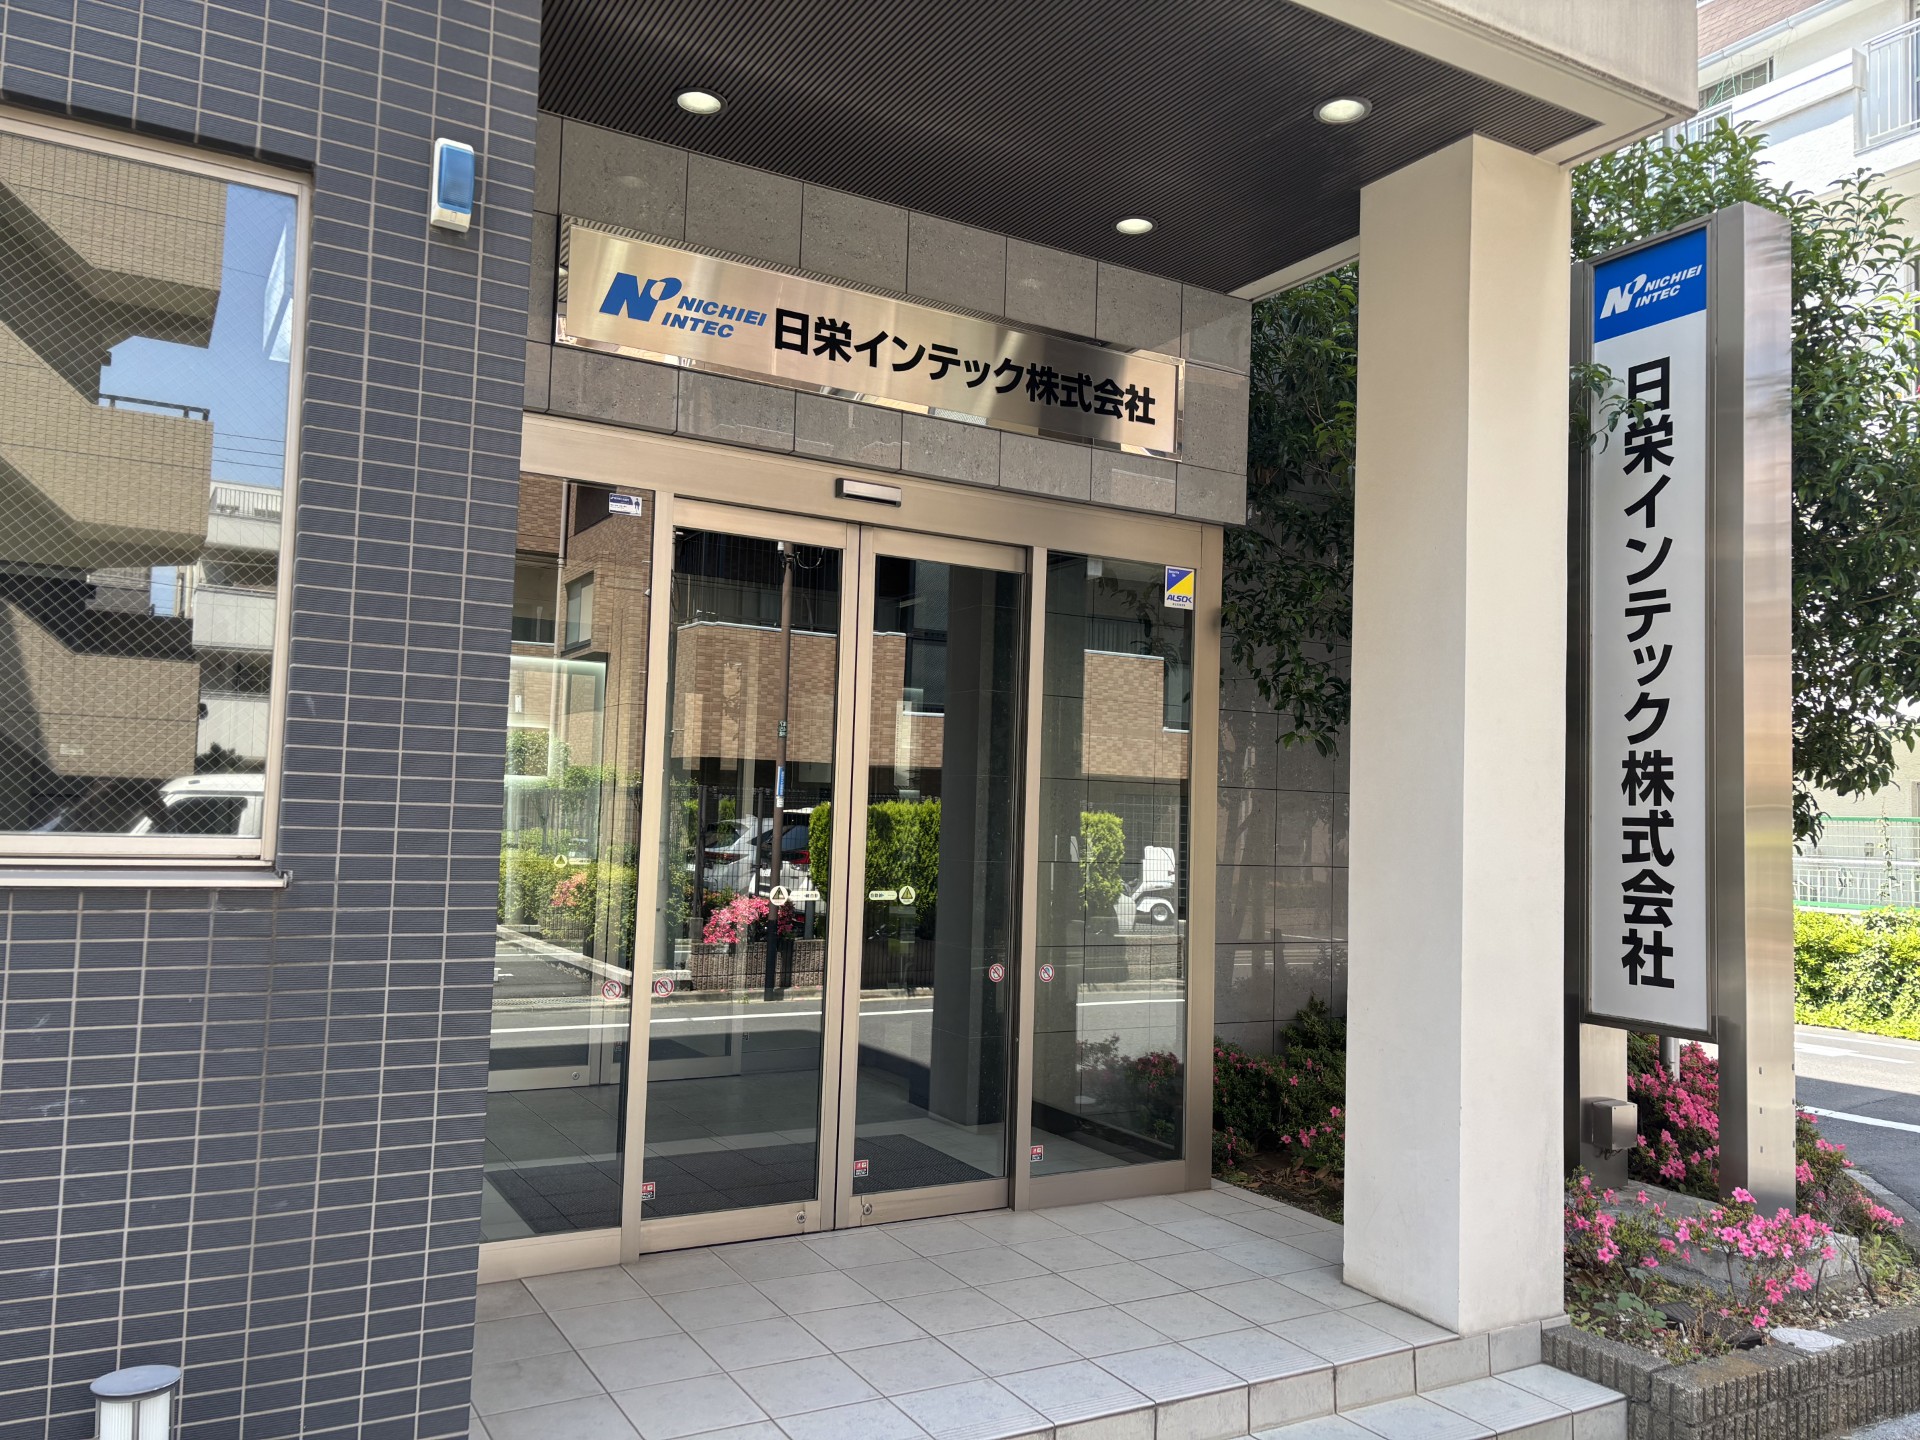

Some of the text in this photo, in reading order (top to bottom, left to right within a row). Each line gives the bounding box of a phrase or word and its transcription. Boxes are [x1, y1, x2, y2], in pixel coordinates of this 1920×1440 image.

[1644, 264, 1702, 293] NICHIEI
[677, 295, 768, 326] NICHIEI
[1635, 284, 1681, 308] INTEC
[661, 312, 734, 338] INTEC
[774, 308, 1156, 426] 日栄インテック株式会社
[1166, 595, 1192, 603] ALSOK
[1621, 356, 1675, 989] 日栄インテック株式会社
